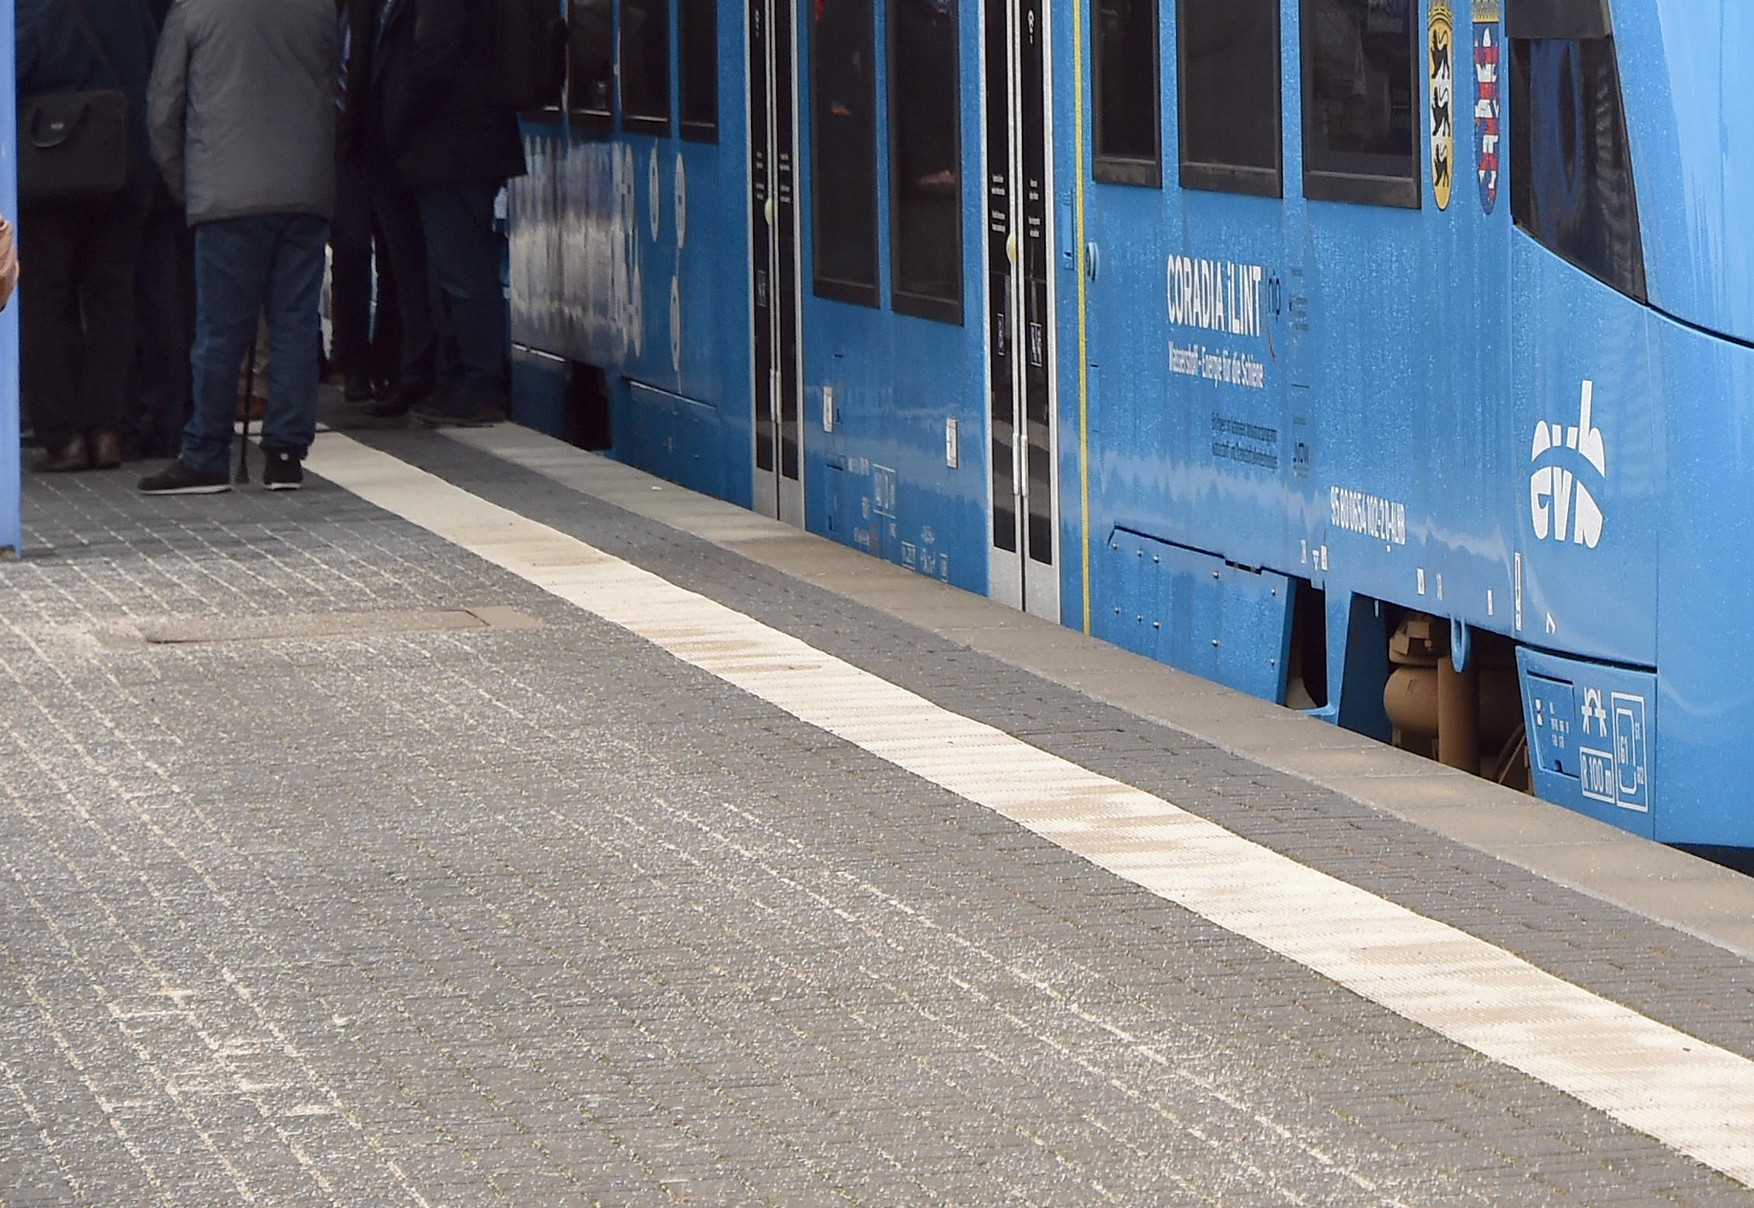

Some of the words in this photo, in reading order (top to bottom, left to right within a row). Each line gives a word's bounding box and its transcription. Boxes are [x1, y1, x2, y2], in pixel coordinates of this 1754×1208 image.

[1167, 254, 1225, 332] CORADIA
[1227, 260, 1262, 337] iLINT
[1531, 380, 1606, 549] evb
